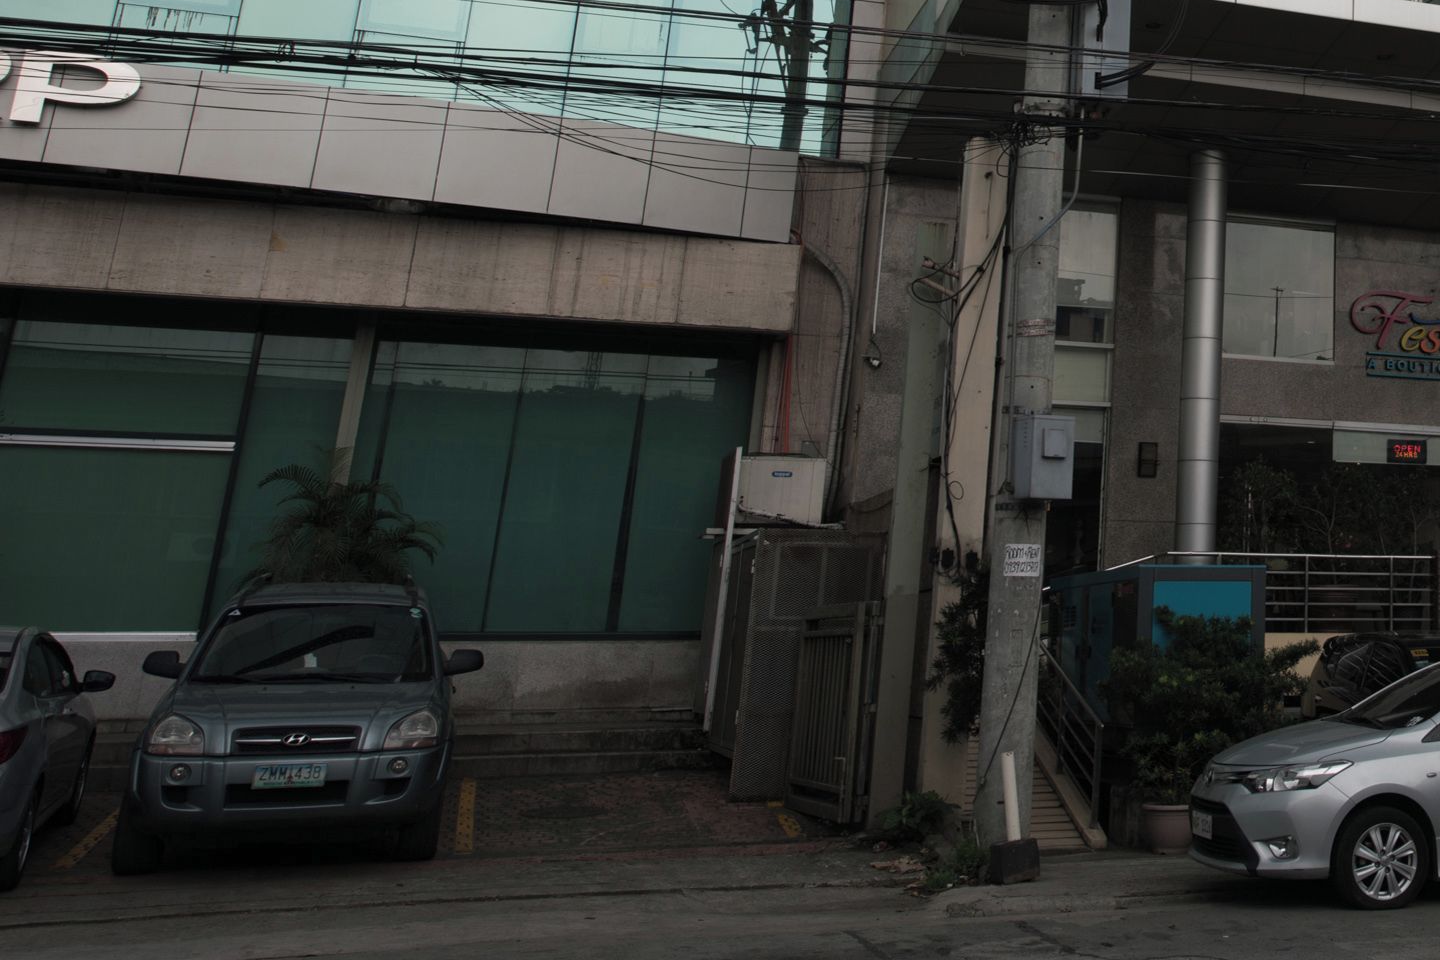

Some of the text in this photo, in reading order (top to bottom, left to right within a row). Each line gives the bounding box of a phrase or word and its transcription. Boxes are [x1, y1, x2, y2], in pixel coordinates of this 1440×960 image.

[0, 50, 142, 125] P
[1366, 358, 1377, 370] A
[1393, 444, 1421, 453] OPEN
[259, 765, 322, 781] ZMM 438
